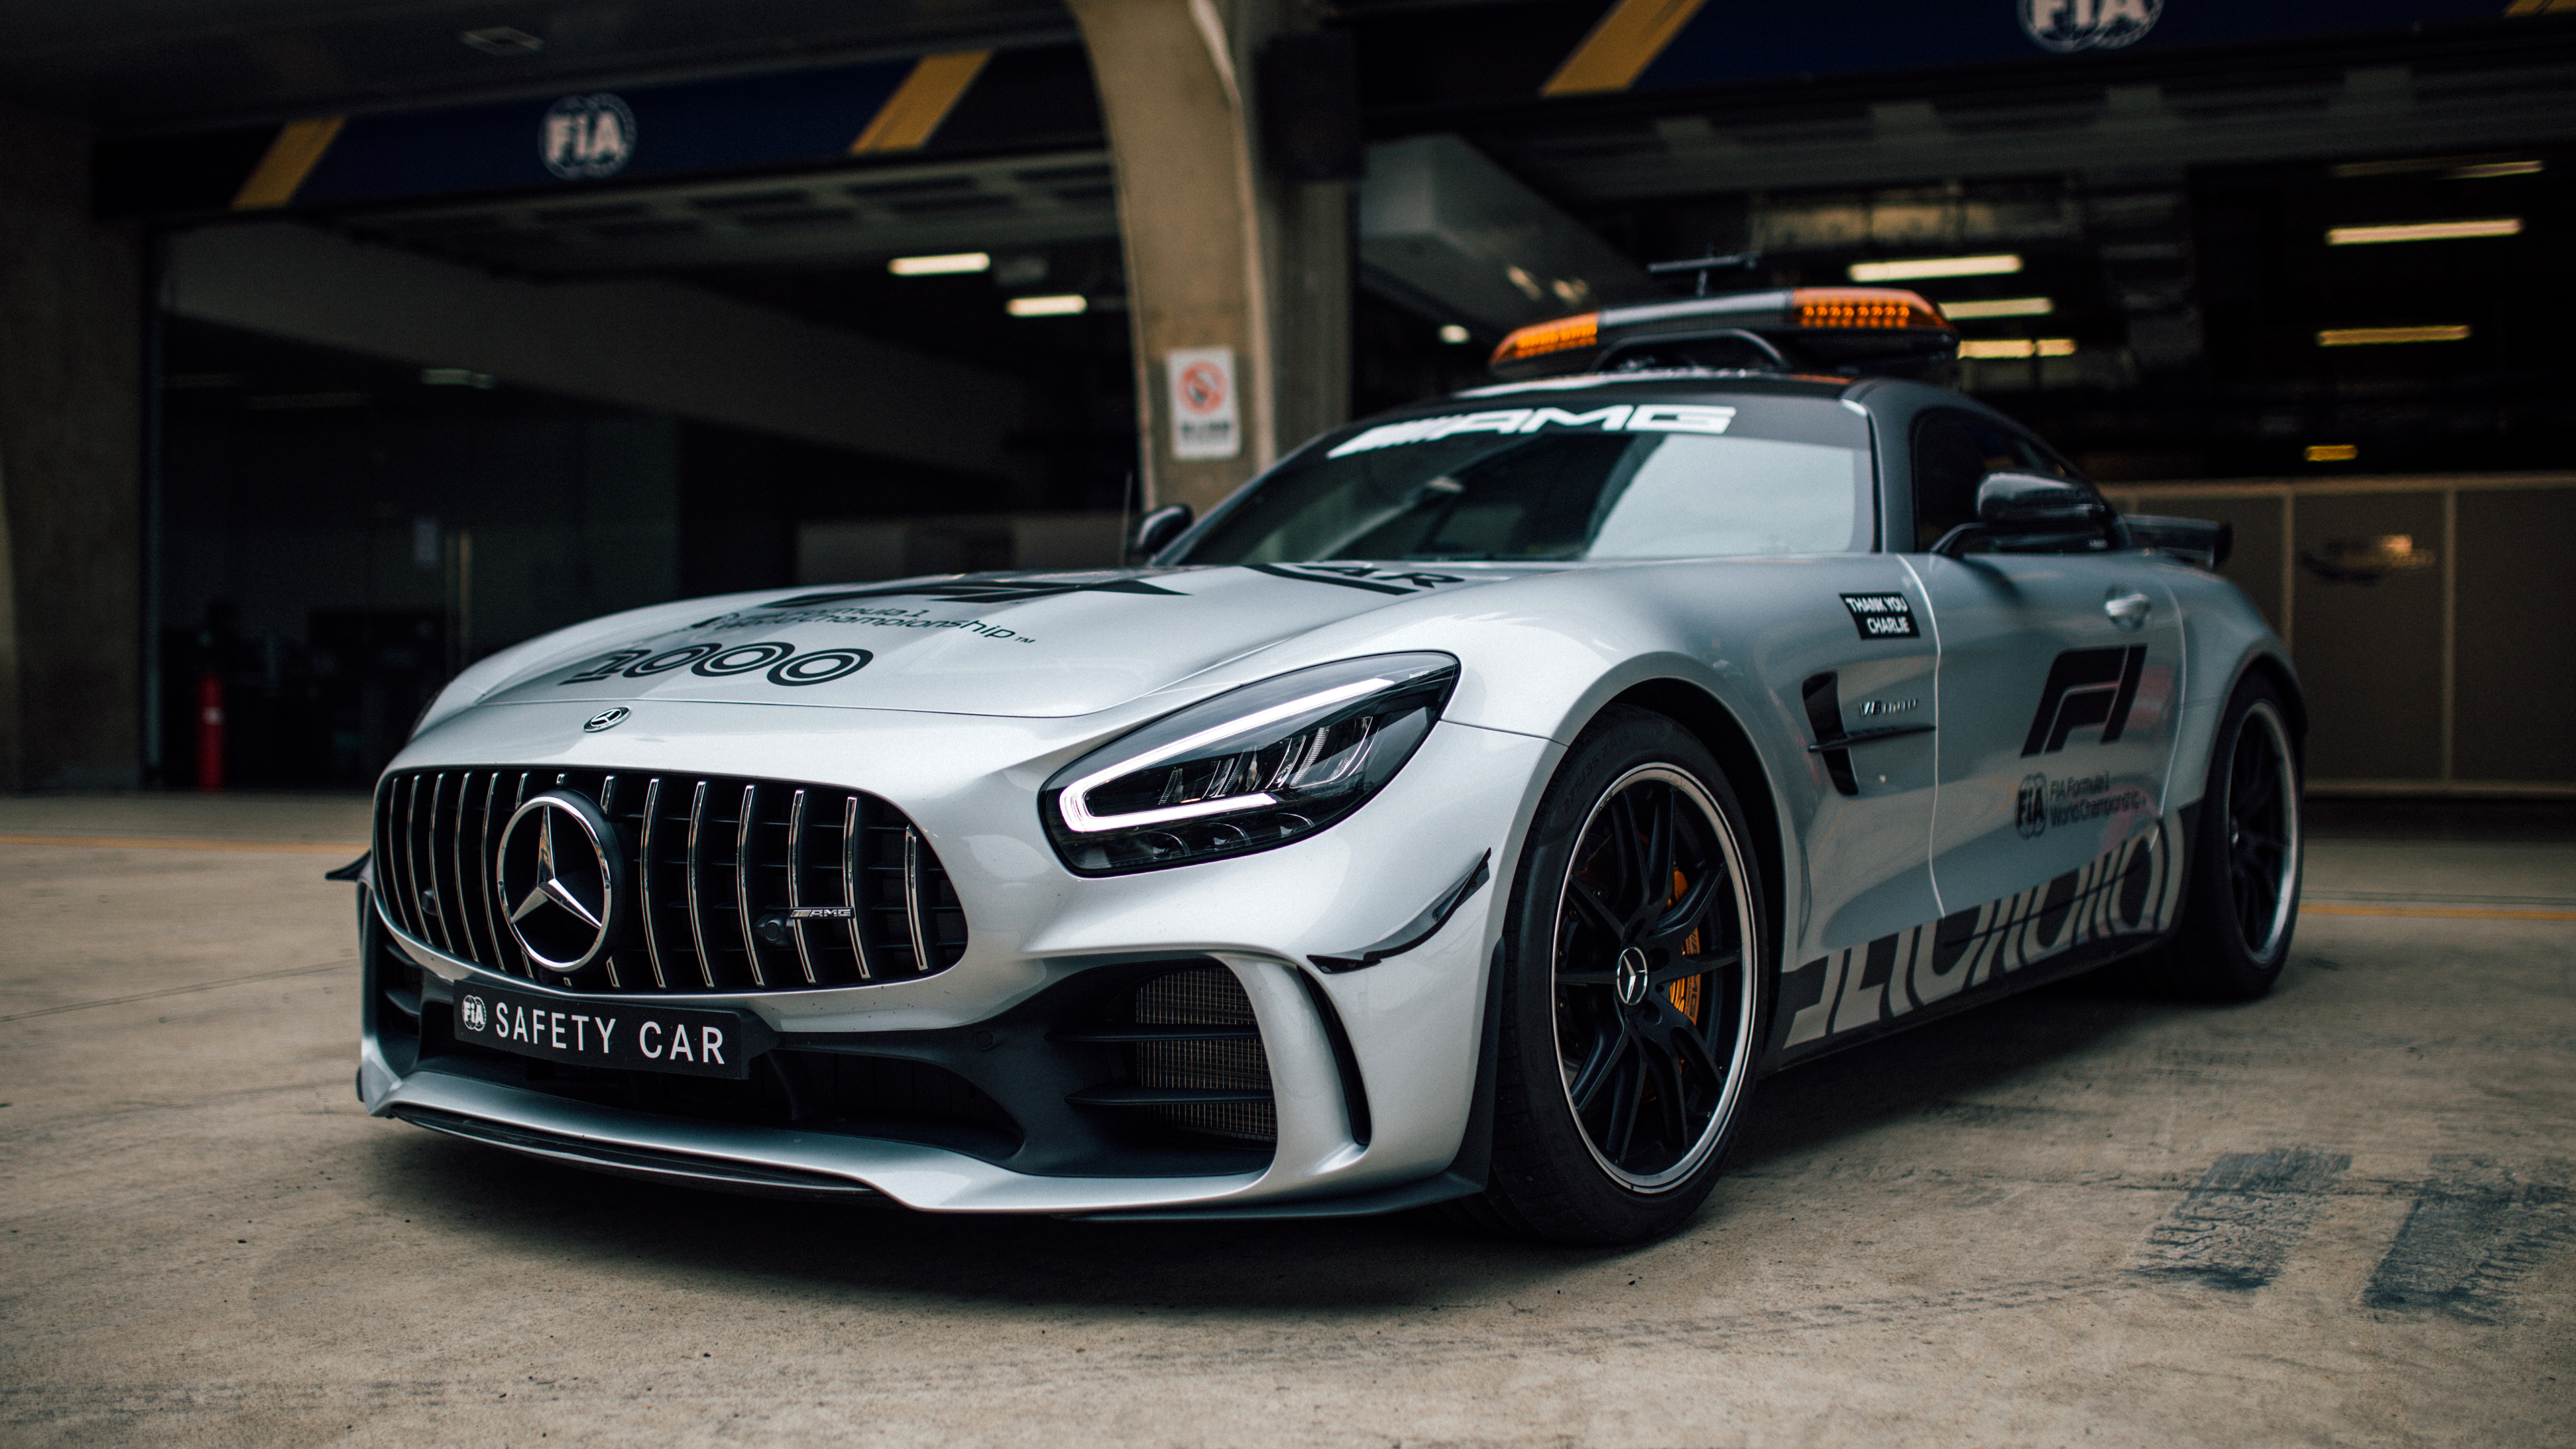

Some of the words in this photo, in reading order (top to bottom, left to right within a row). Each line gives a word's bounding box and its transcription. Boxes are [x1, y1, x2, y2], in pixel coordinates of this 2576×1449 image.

[1845, 596, 1888, 613] THANK
[1883, 596, 1908, 612] YOU
[1867, 616, 1910, 634] CHARLIE
[558, 641, 873, 686] 1000
[496, 1002, 616, 1054] SAFETY
[639, 1021, 725, 1065] CAR
